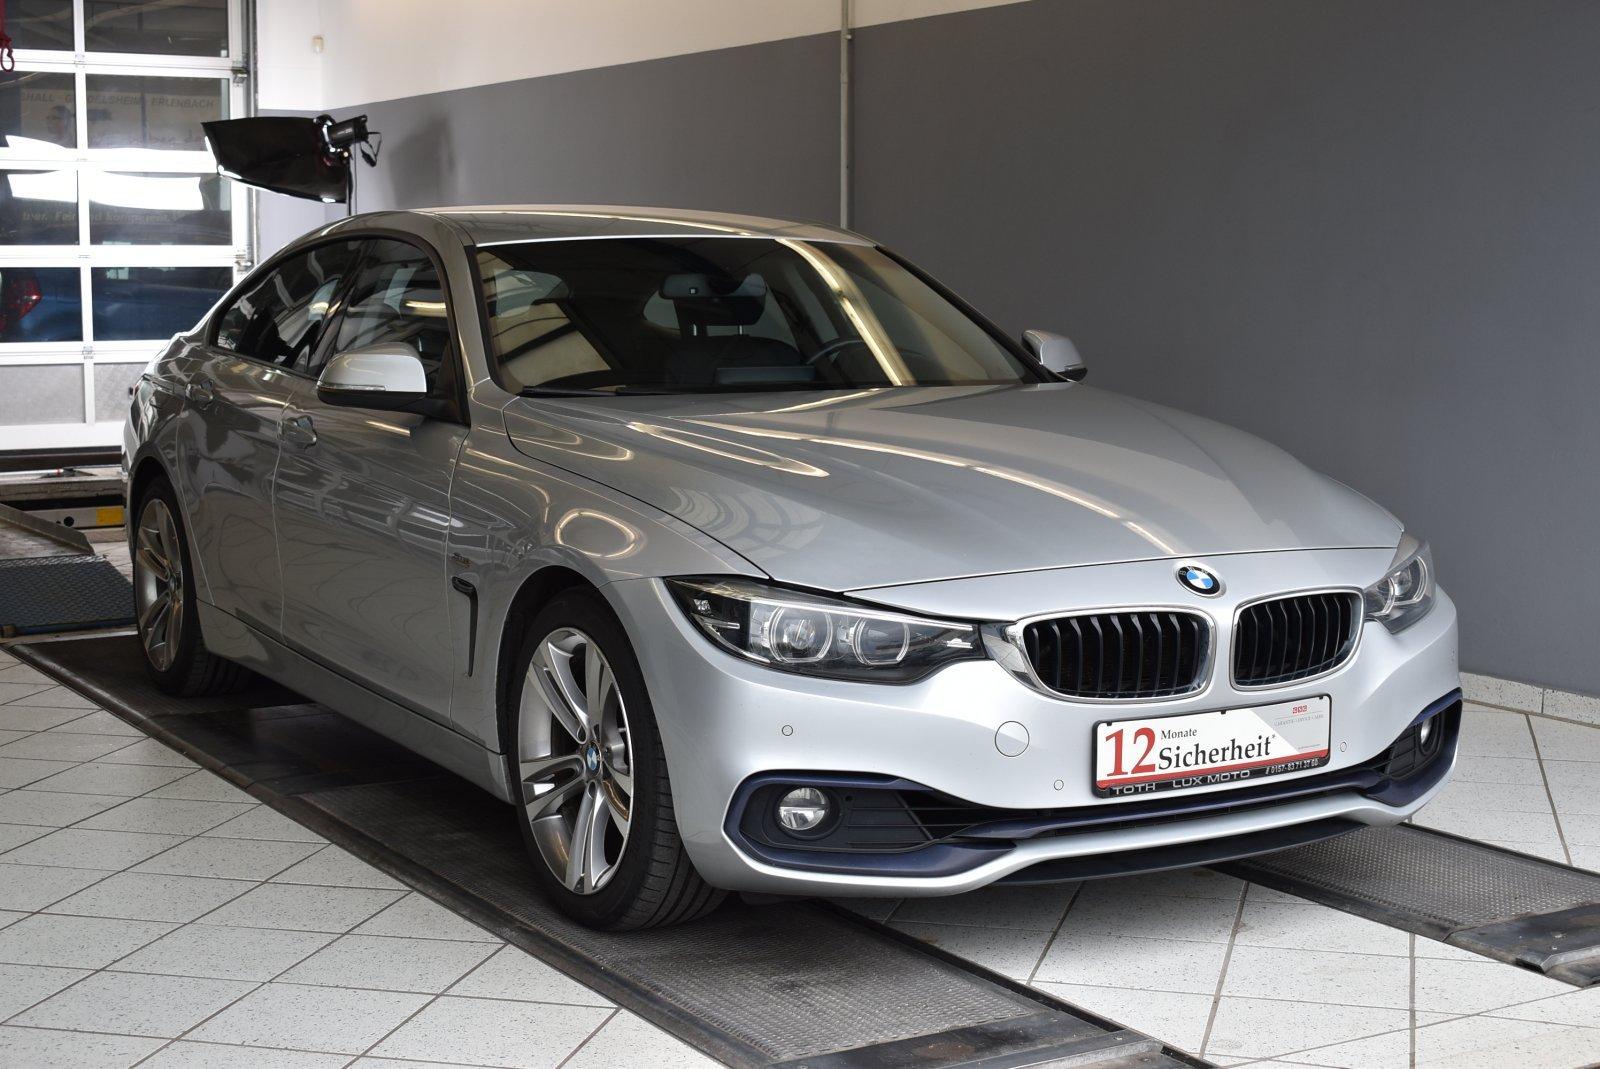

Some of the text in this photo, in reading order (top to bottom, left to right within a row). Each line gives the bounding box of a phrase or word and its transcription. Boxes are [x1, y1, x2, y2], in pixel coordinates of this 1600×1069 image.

[1161, 728, 1198, 740] Monate
[1105, 727, 1156, 777] 12
[1112, 770, 1251, 795] TOTH LUX MOTO
